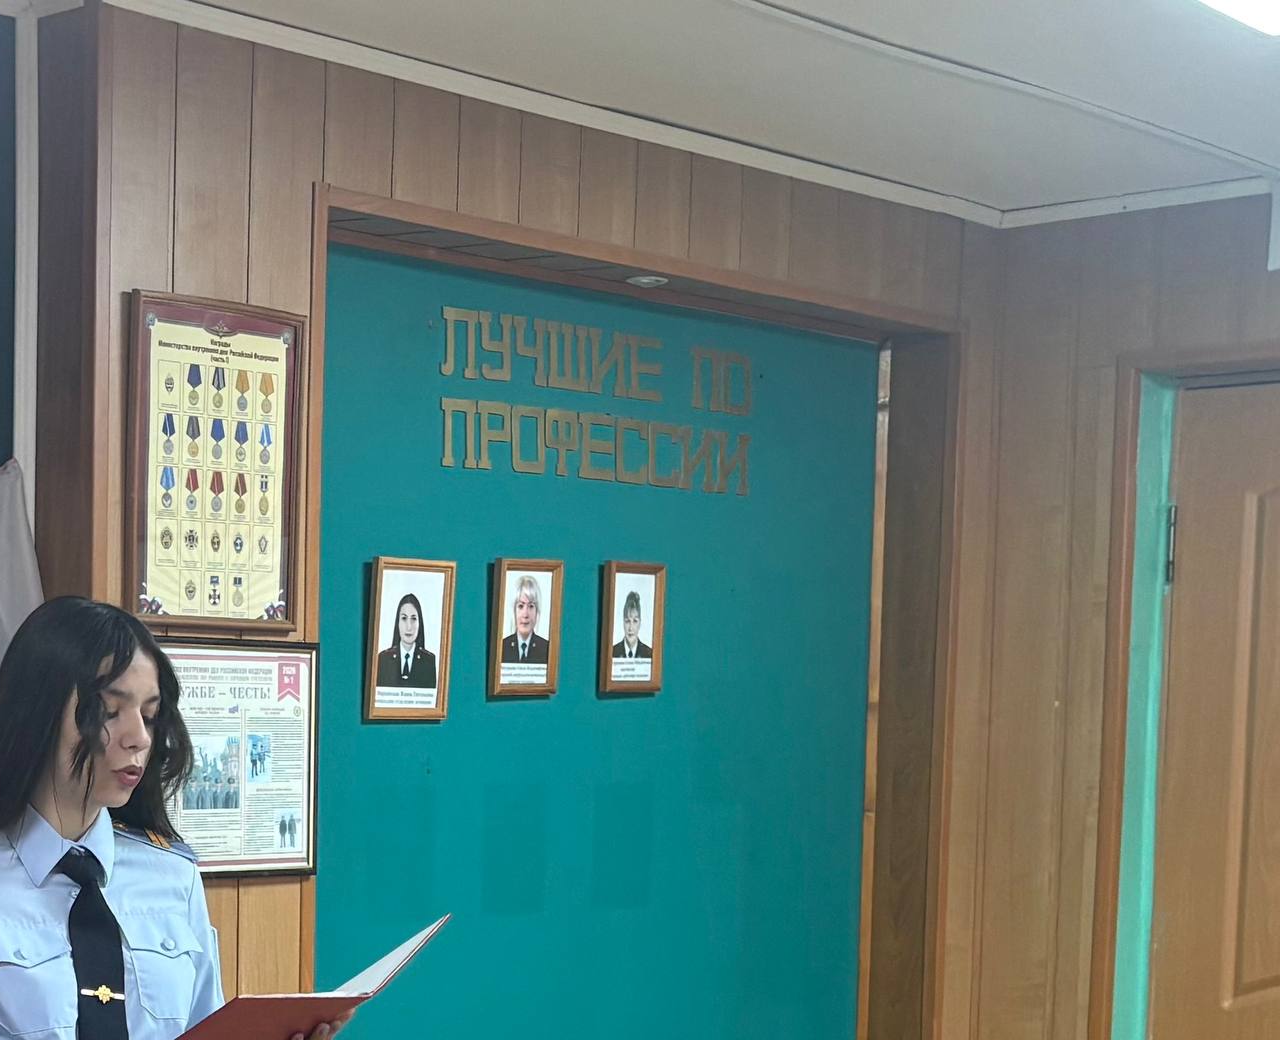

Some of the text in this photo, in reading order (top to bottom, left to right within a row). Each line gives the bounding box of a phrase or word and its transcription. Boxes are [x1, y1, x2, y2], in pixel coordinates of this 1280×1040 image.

[440, 306, 752, 416] ЛУЧШИЕ ПО
[440, 396, 753, 496] ПРОФЕССИИ
[230, 686, 271, 700] ЧЕСТЬ!
